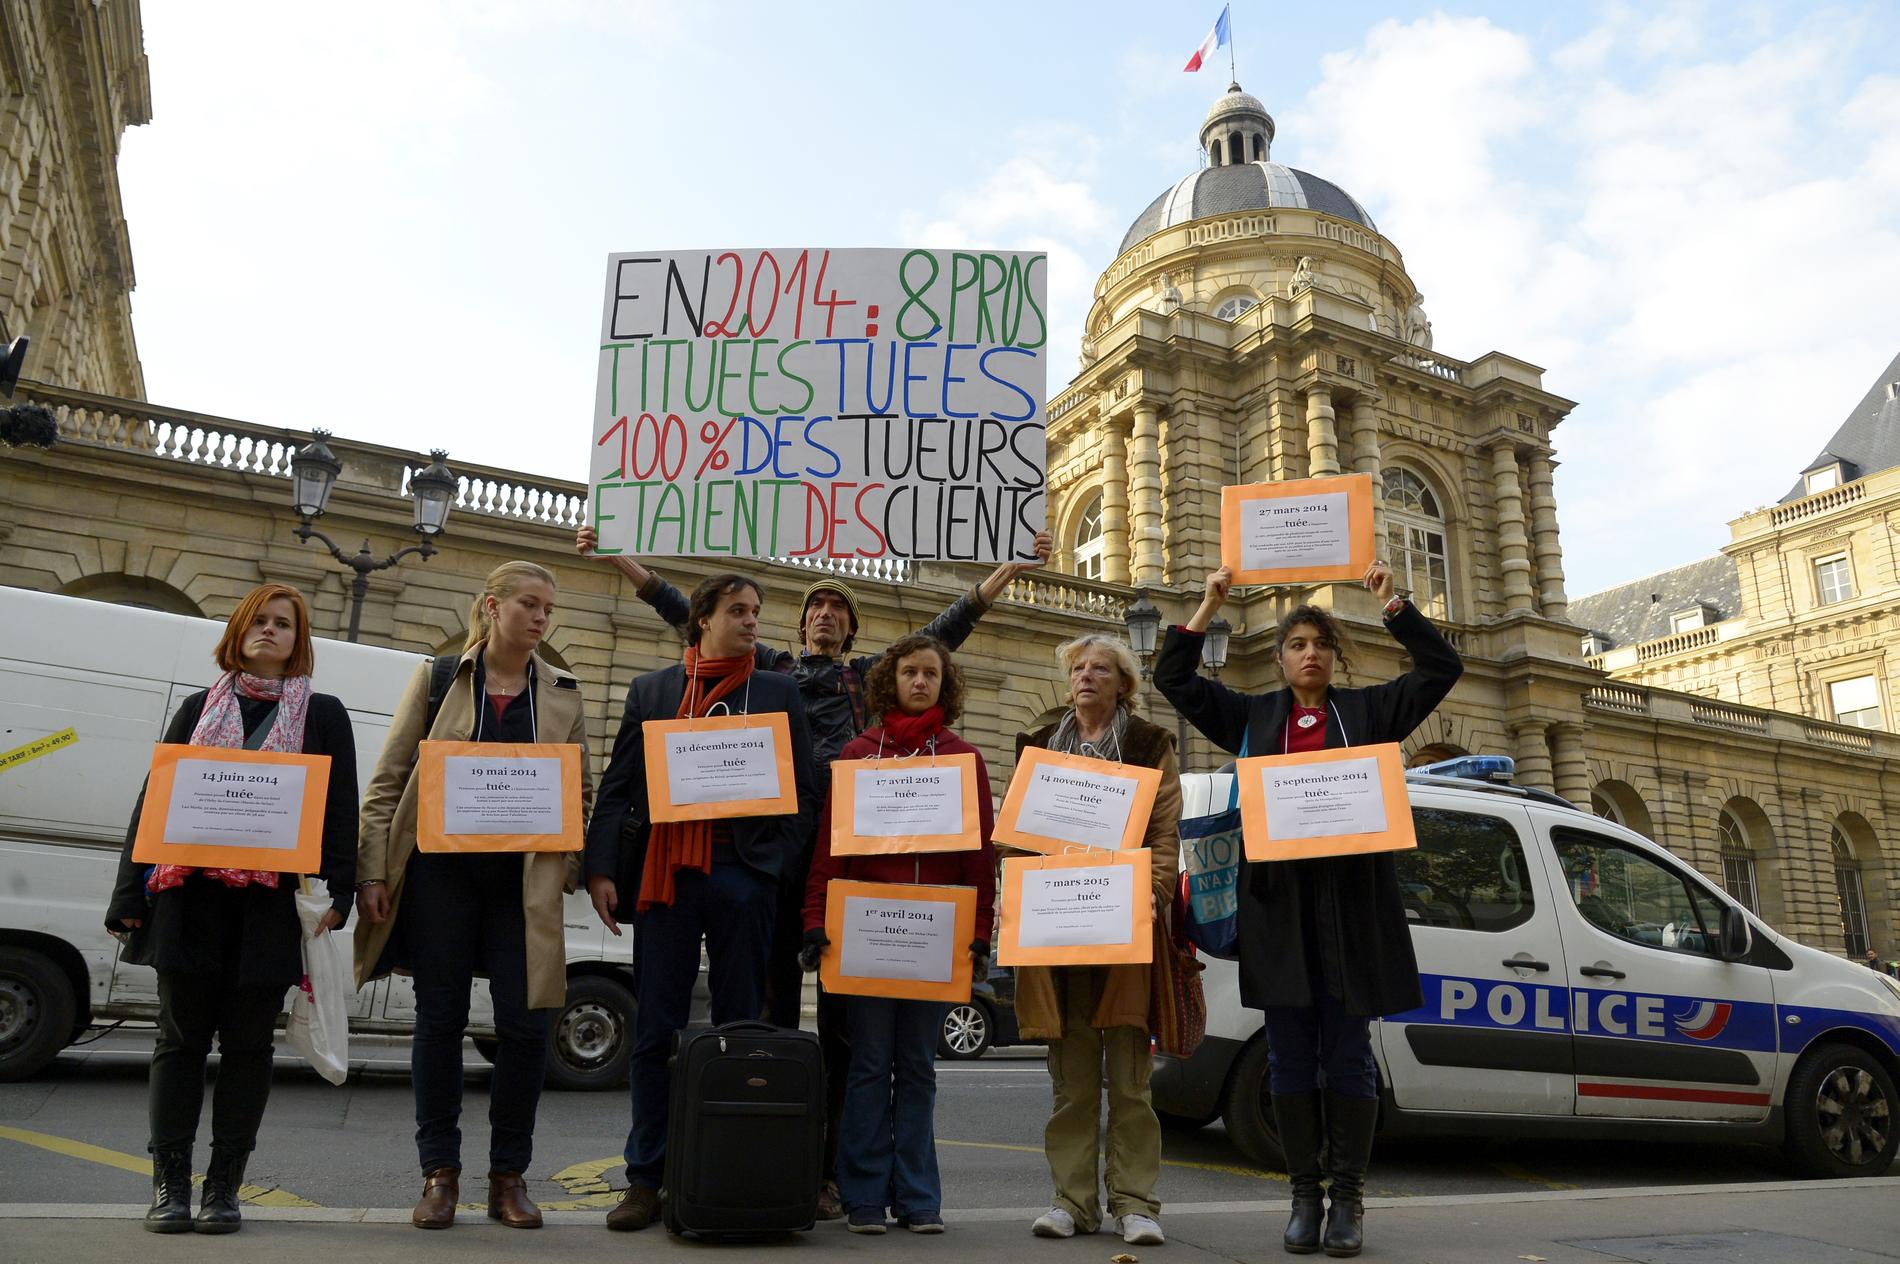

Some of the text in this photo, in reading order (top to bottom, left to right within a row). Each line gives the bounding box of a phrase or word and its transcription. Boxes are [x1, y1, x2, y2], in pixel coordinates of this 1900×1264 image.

[609, 255, 711, 340] EN
[895, 249, 942, 343] 8
[948, 252, 1047, 350] PROS
[815, 323, 1038, 422] TUÉES
[734, 416, 842, 479] DES
[836, 412, 1047, 489] TUEURS
[594, 467, 1044, 562] ÉTAIENT DES CLIENTS
[1258, 504, 1328, 517] 27 mars 2014
[1285, 518, 1308, 528] tuée
[675, 741, 764, 754] 31 décembre 2014
[723, 757, 747, 767] tuée
[471, 767, 537, 777] 19 mai 2014
[201, 771, 279, 786] 14 juin 2014
[876, 776, 940, 787] 17 avril 2015
[1274, 772, 1368, 788] 5 septembre 2014
[486, 782, 511, 791] tuée
[1040, 774, 1126, 796] 14 novembre 2014
[225, 789, 254, 799] tuée
[894, 790, 918, 798] tuée
[1304, 788, 1330, 798] tuée
[1079, 794, 1102, 805] tuée
[1044, 877, 1110, 889] 7 mars 2015
[1077, 891, 1102, 901] tuée
[865, 909, 934, 922] 1er avril 2014
[885, 925, 908, 935] tuée
[1440, 979, 1666, 1037] POLICE
